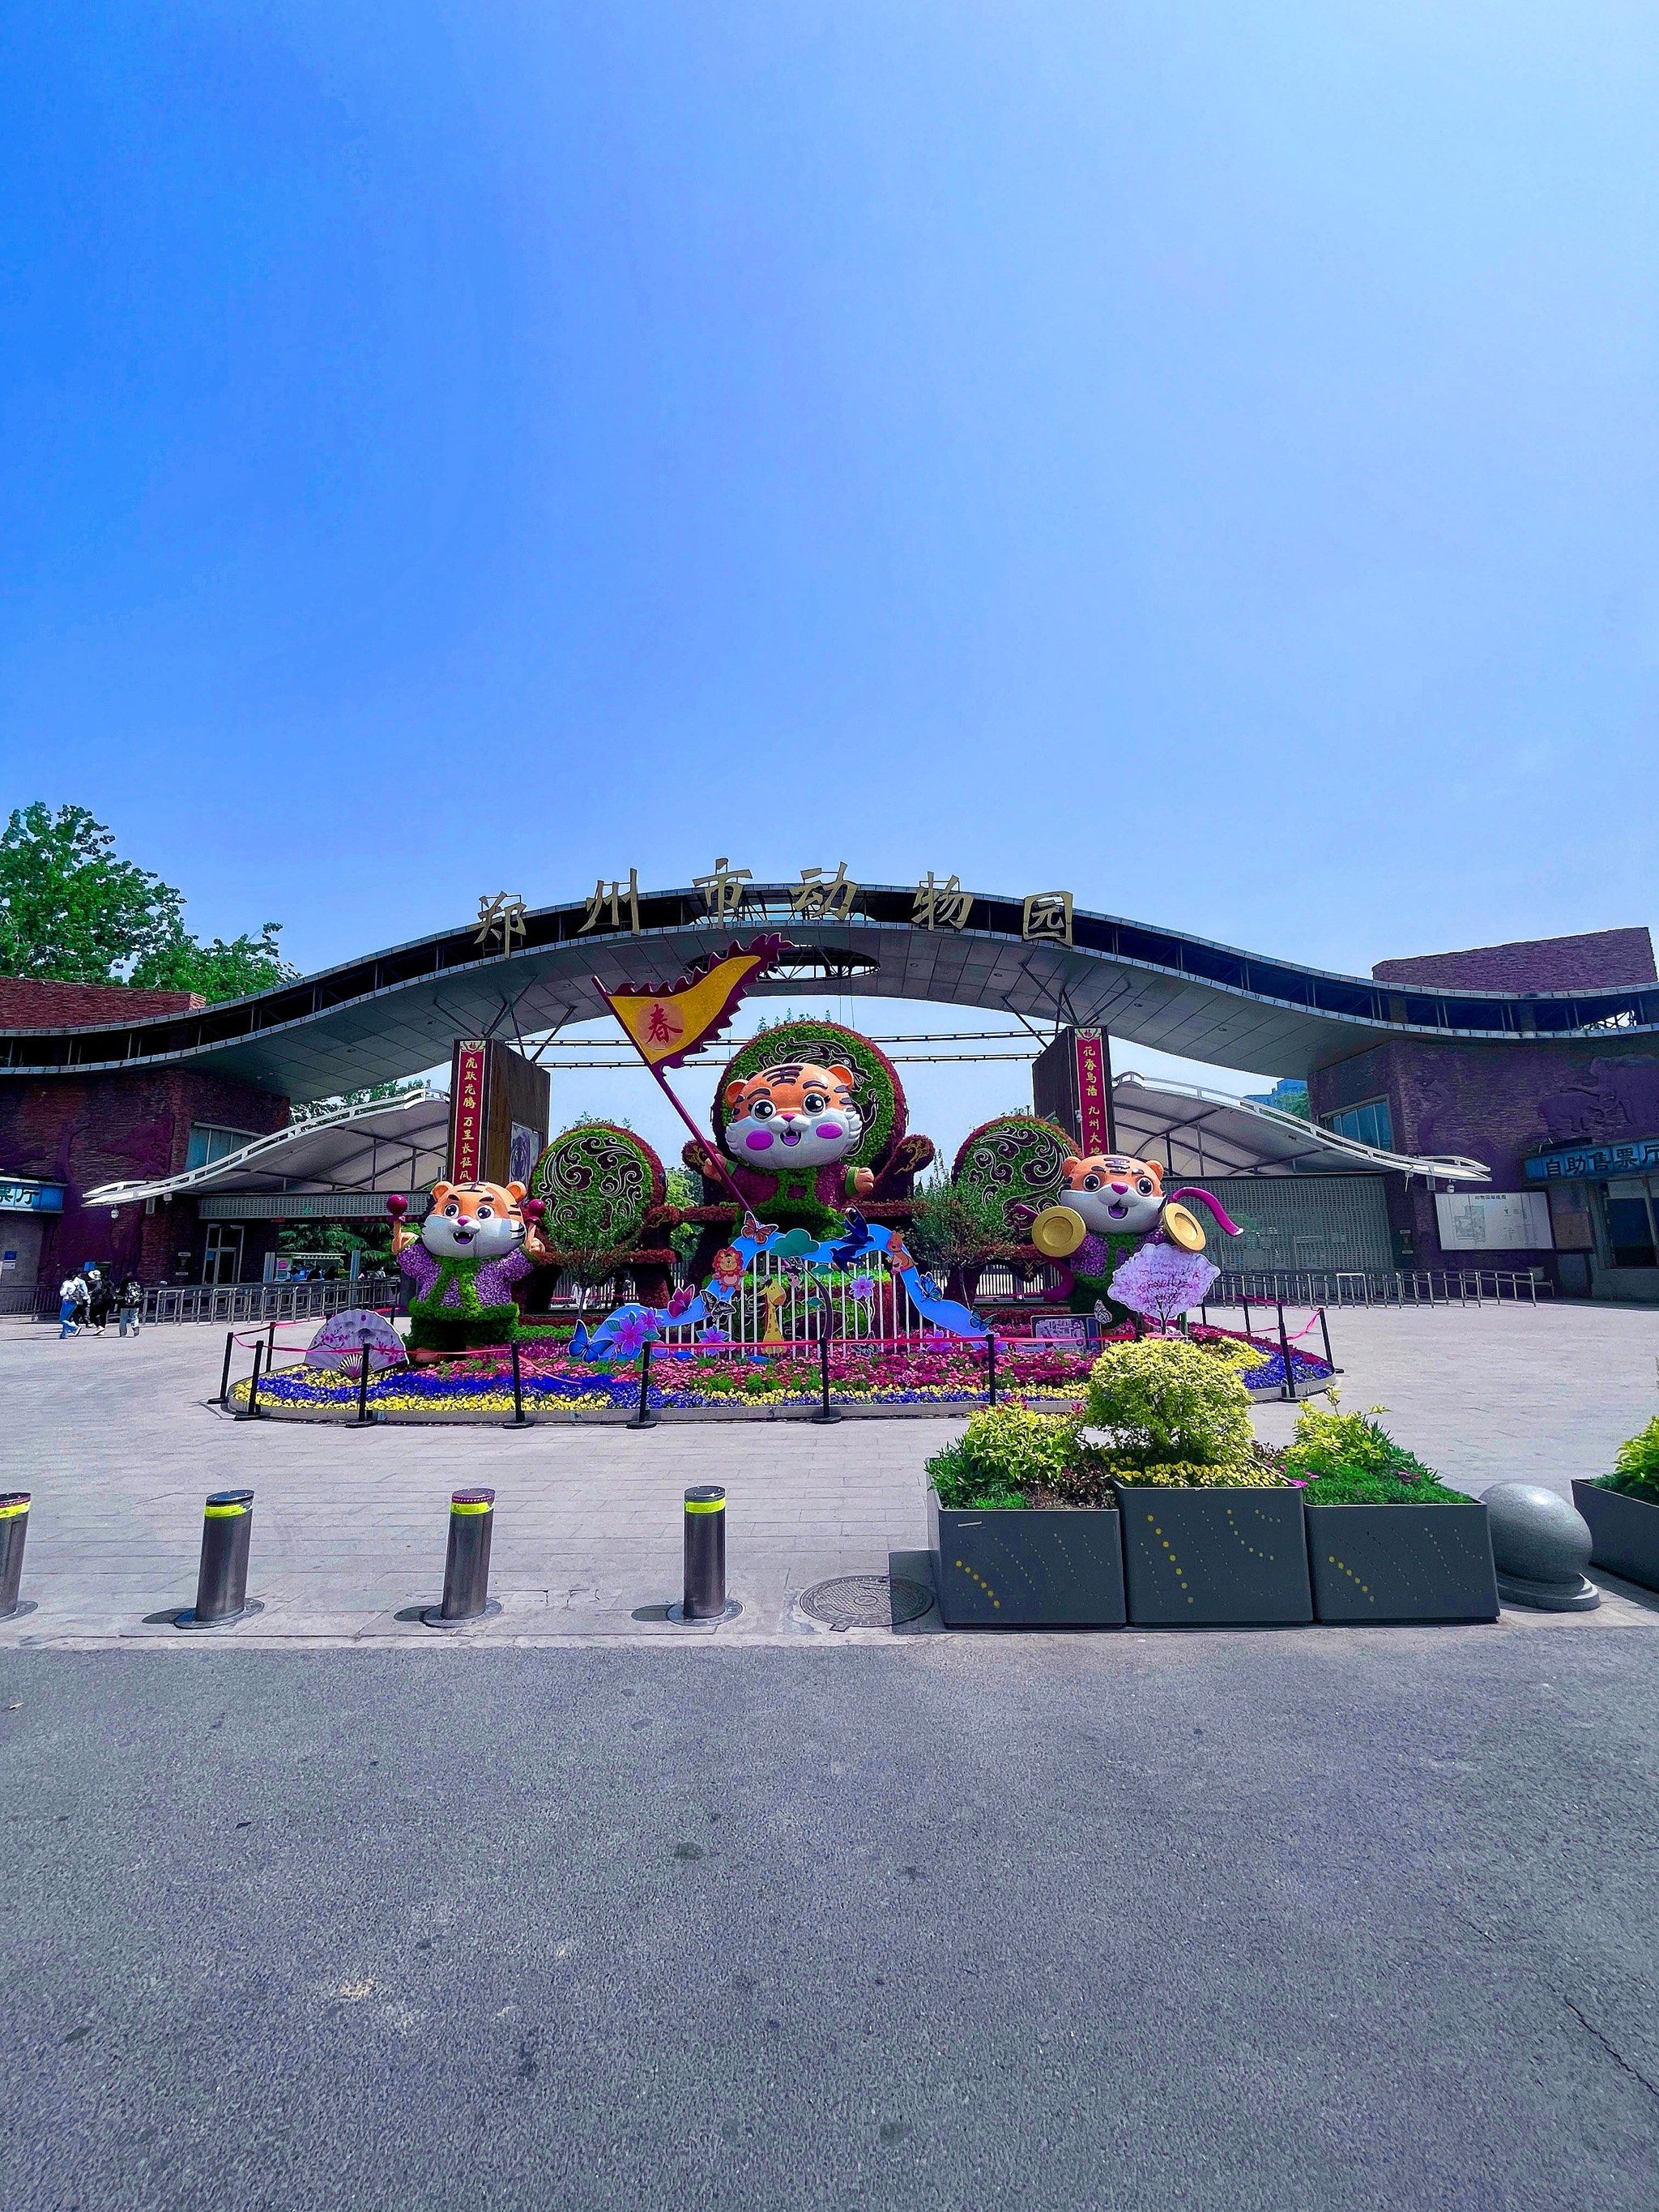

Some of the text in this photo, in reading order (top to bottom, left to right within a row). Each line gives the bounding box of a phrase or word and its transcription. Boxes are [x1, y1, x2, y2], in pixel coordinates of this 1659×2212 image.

[473, 857, 1074, 959] 郑州市动物园
[646, 1003, 684, 1044] 春
[463, 1057, 478, 1109] 虎跃龙腾
[1083, 1045, 1098, 1096] 花香鸟语
[1546, 1143, 1659, 1176] 自助售票厅
